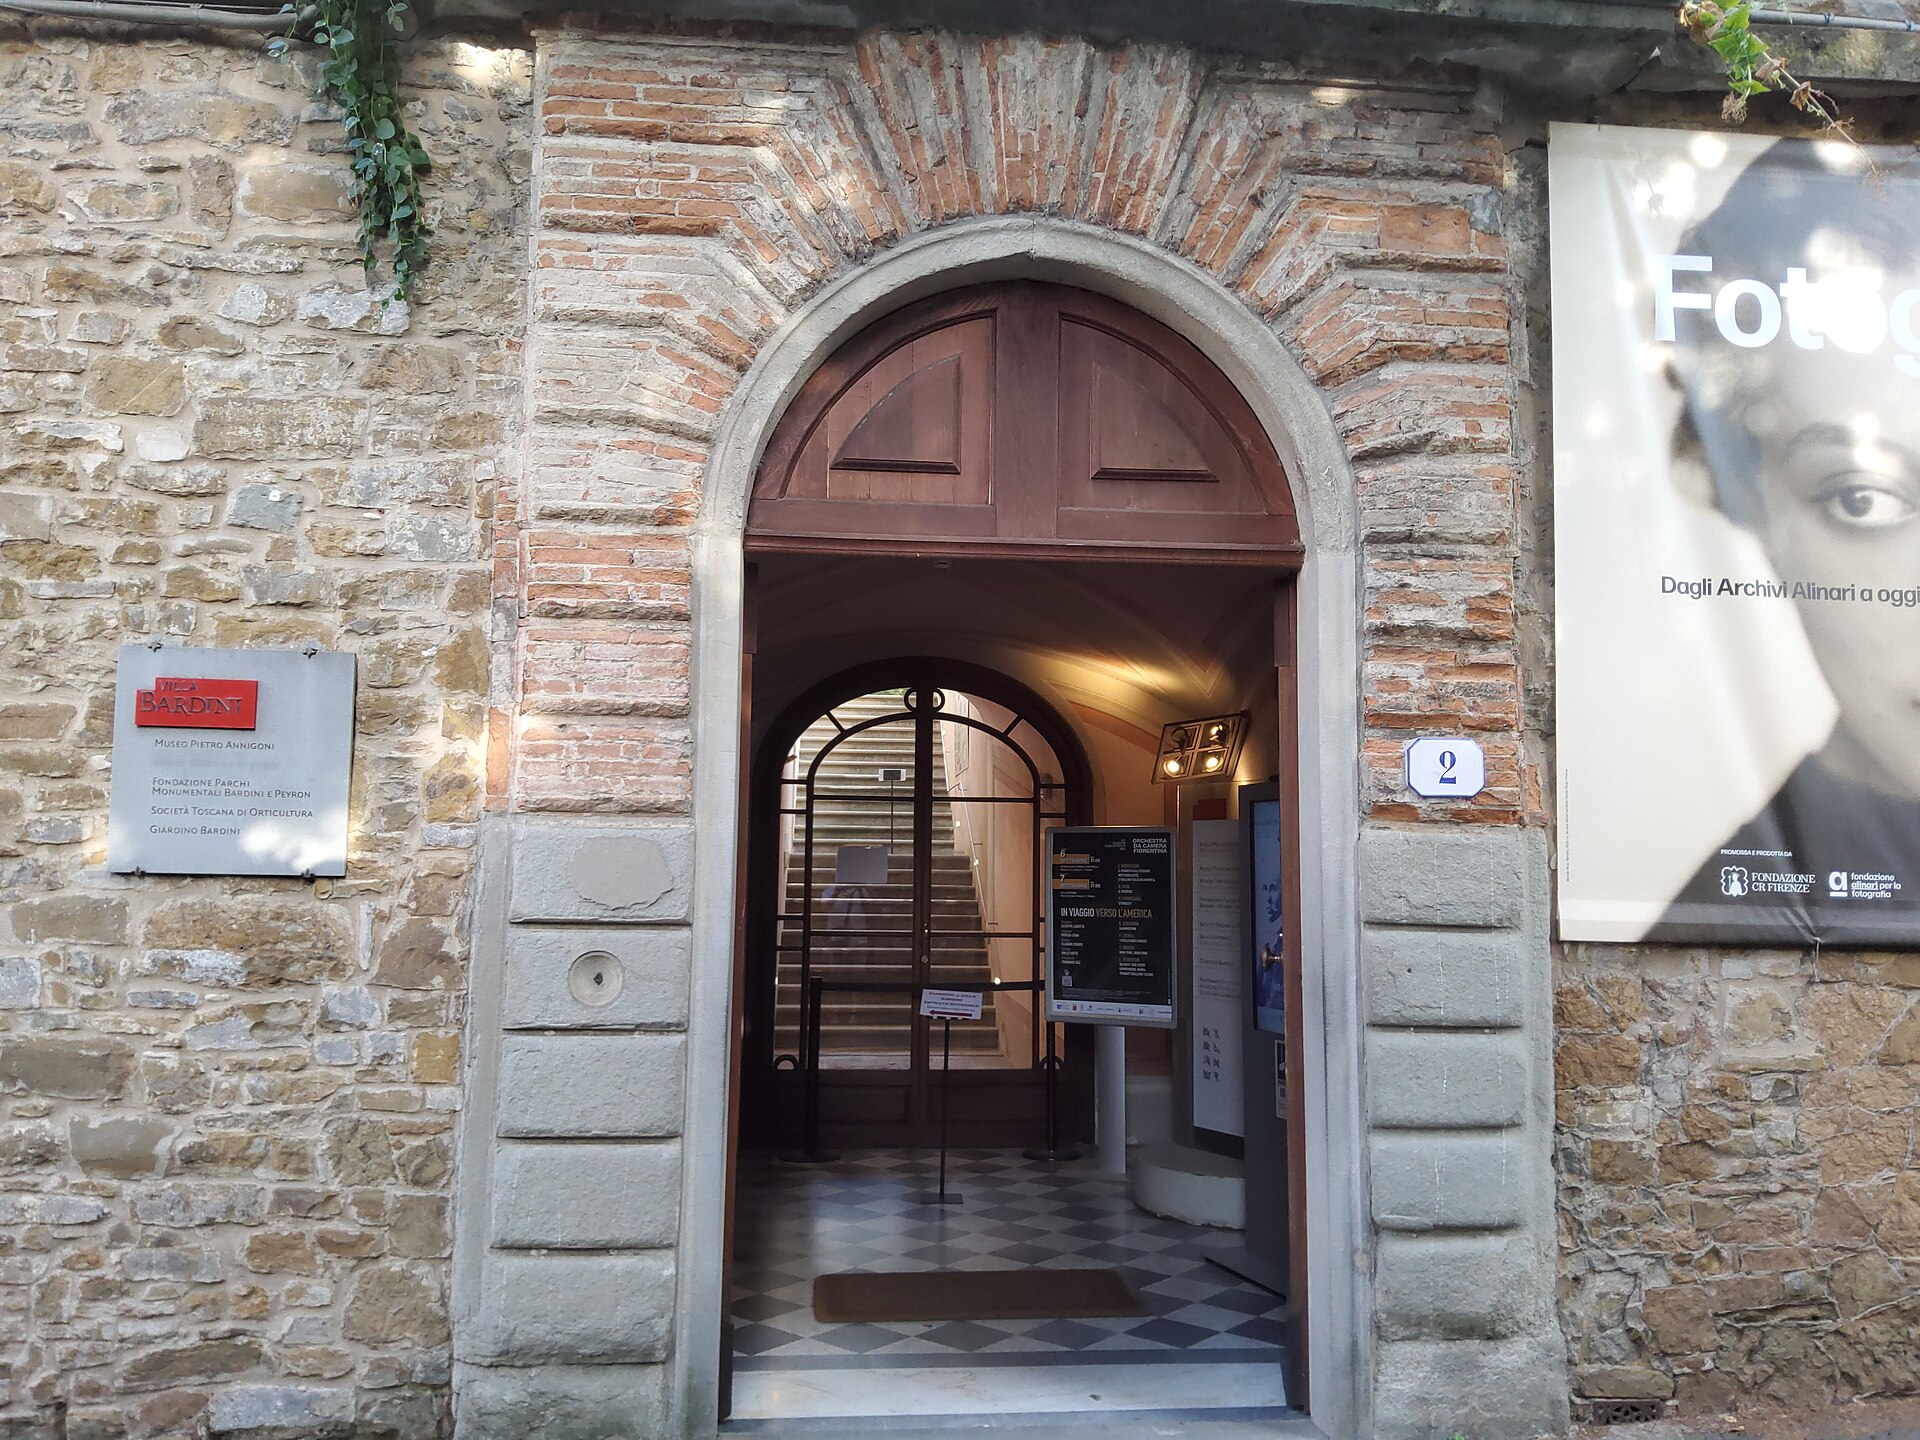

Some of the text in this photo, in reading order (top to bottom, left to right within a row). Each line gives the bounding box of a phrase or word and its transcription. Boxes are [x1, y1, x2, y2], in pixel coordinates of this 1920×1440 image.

[1661, 575, 1712, 599] Dagli
[1716, 578, 1788, 599] Archivi
[1791, 581, 1856, 601] Alinari
[1859, 587, 1873, 602] a
[159, 680, 198, 692] VILLA
[141, 691, 243, 716] BARDINI
[154, 739, 275, 750] MUSEO PIETRO ANNIGONI
[1439, 750, 1457, 785] 2
[152, 777, 250, 788] FONDAZIONE PARCHI
[152, 787, 222, 797] MONUMENTALI
[224, 788, 264, 798] BARDINI
[274, 789, 311, 798] PEYRON
[151, 806, 313, 818] SOCIETÀ TOSCANA DI ORTICULTURA
[149, 825, 240, 835] GIARDINO BARDINI
[1060, 849, 1066, 858] 6
[1060, 874, 1065, 882] 7
[1751, 872, 1816, 884] FONDAZIONE
[1851, 872, 1895, 882] fondazione
[1751, 882, 1811, 893] CR FIRENZE
[1851, 881, 1902, 890] alinari per la
[1851, 889, 1892, 899] fotografia
[1060, 907, 1152, 918] IN VIAGGIO VERSO L'AMERICA
